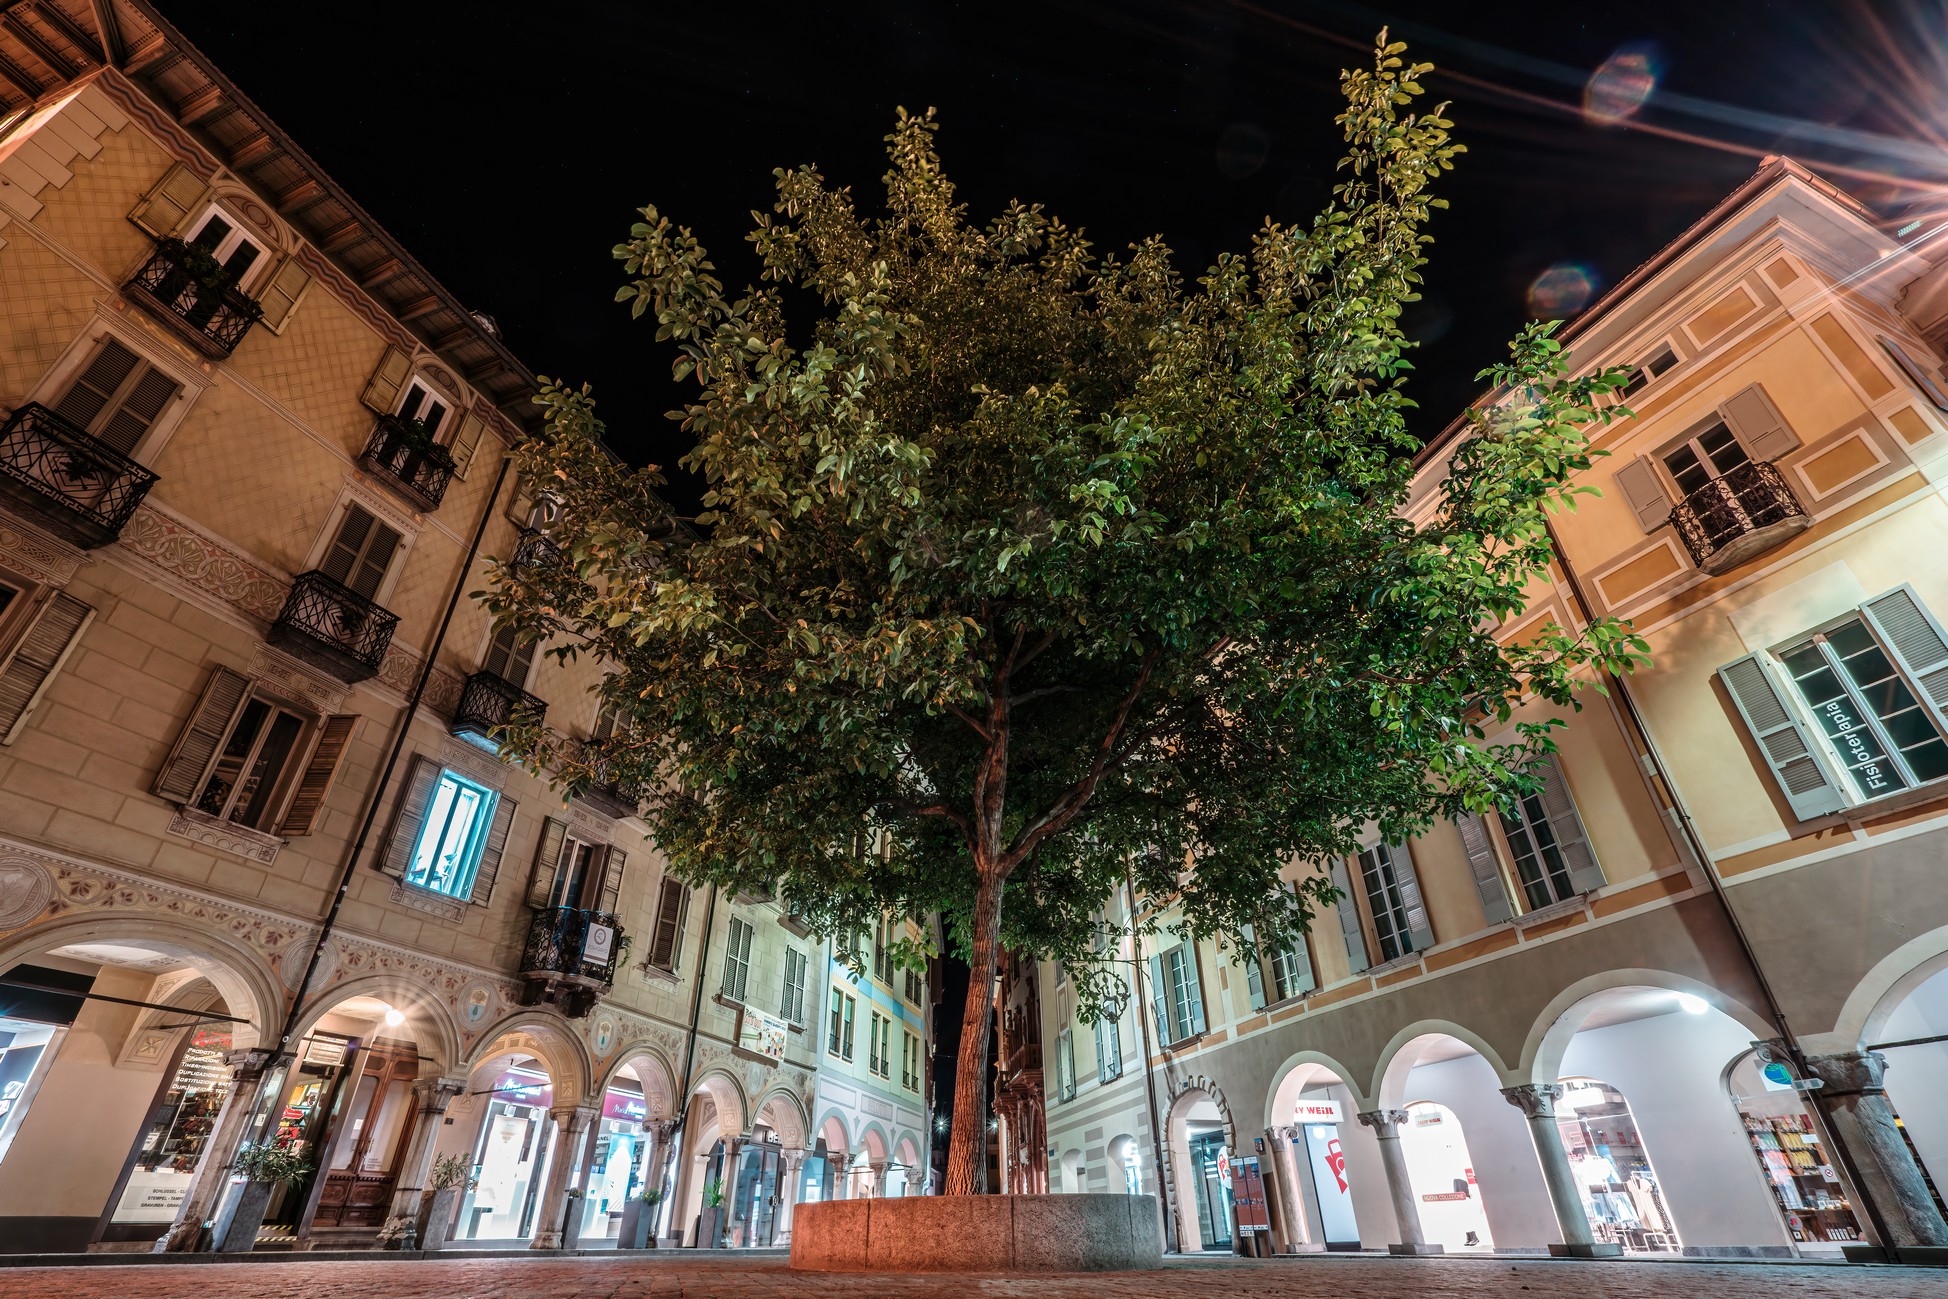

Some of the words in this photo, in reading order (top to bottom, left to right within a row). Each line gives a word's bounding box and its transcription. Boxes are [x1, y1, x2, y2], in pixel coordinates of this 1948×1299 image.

[1826, 702, 1888, 790] Fisioterapia
[178, 1069, 219, 1079] DUPLICAZIONE
[175, 1076, 217, 1085] SOSTITUZIONE
